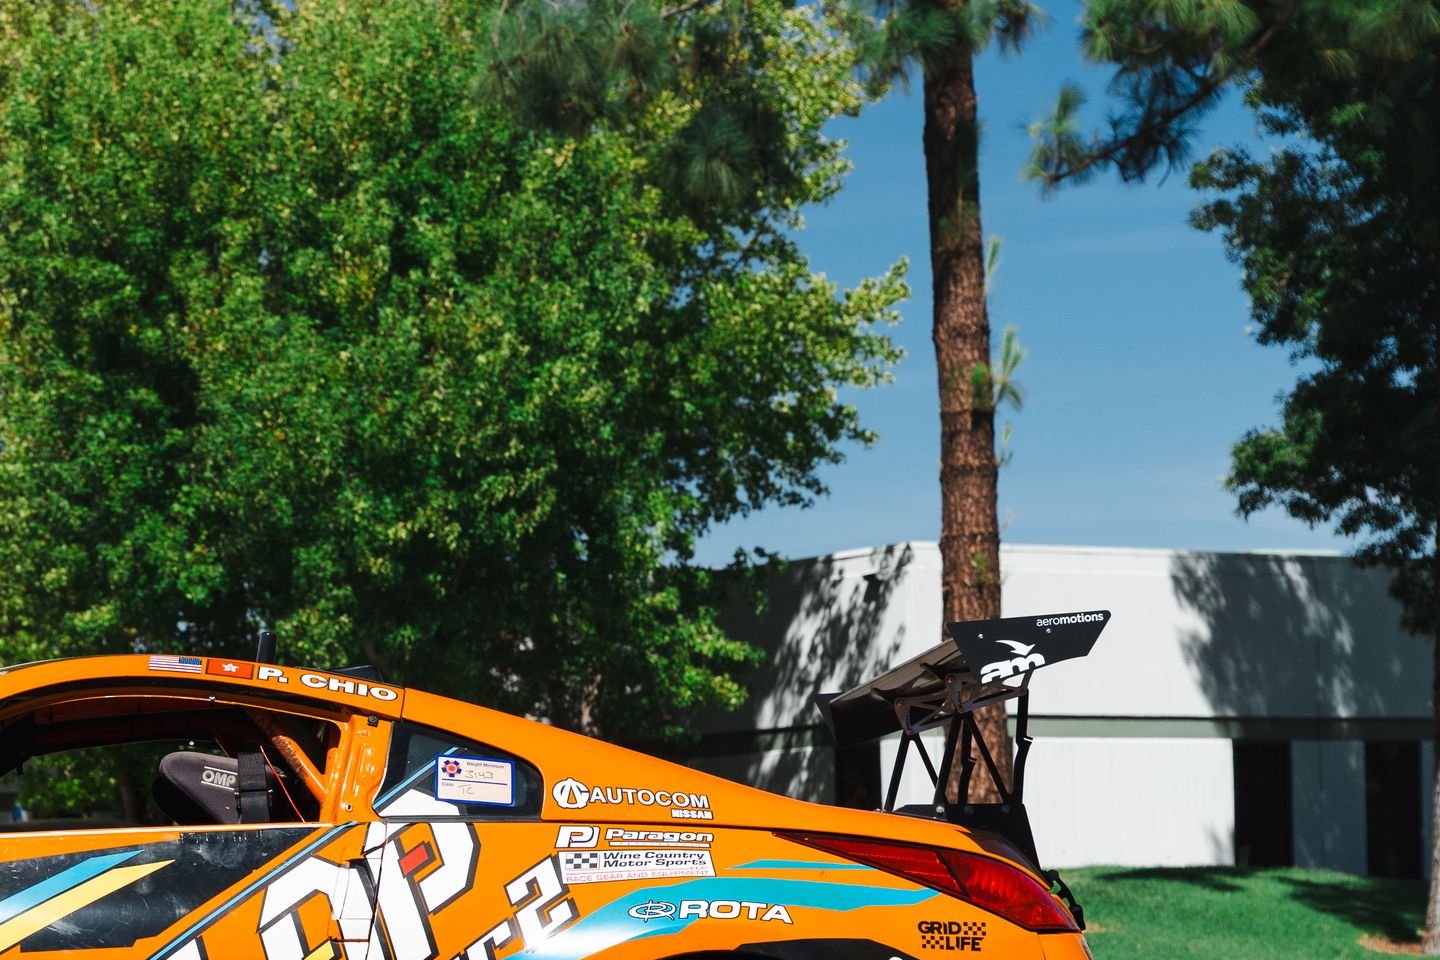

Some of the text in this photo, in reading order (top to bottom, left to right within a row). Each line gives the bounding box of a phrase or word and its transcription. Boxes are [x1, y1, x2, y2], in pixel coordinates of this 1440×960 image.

[1036, 612, 1104, 627] aeromotions
[257, 665, 399, 701] P. CHIO
[202, 770, 236, 786] OMP
[589, 786, 710, 809] AUTOCOM
[671, 808, 714, 819] NISSAN
[605, 828, 714, 842] Paragon
[603, 851, 705, 861] Wine Country
[603, 858, 707, 868] Motor Sports
[566, 874, 593, 883] RACE
[596, 873, 624, 882] GEAR
[652, 870, 709, 878] EQUIPMENT
[678, 899, 794, 924] ROTA
[918, 921, 962, 935] GRID
[945, 936, 984, 951] LIFE
